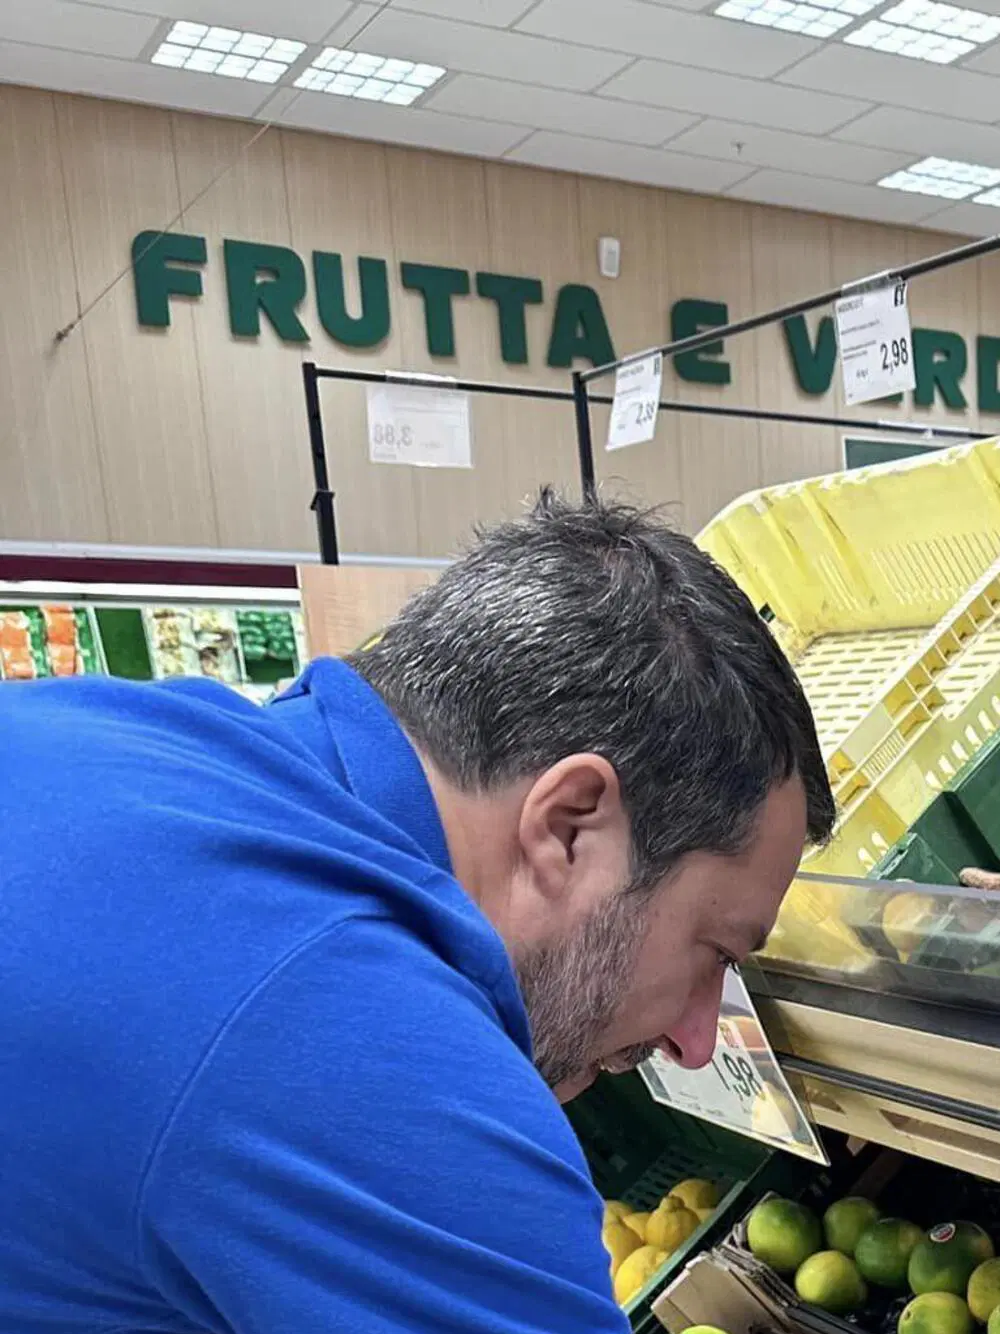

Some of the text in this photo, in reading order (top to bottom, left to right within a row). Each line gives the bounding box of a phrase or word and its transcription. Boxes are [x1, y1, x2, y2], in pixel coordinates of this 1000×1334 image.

[131, 229, 616, 369] FRUTTA
[669, 298, 731, 385] E
[880, 337, 909, 376] 2,98
